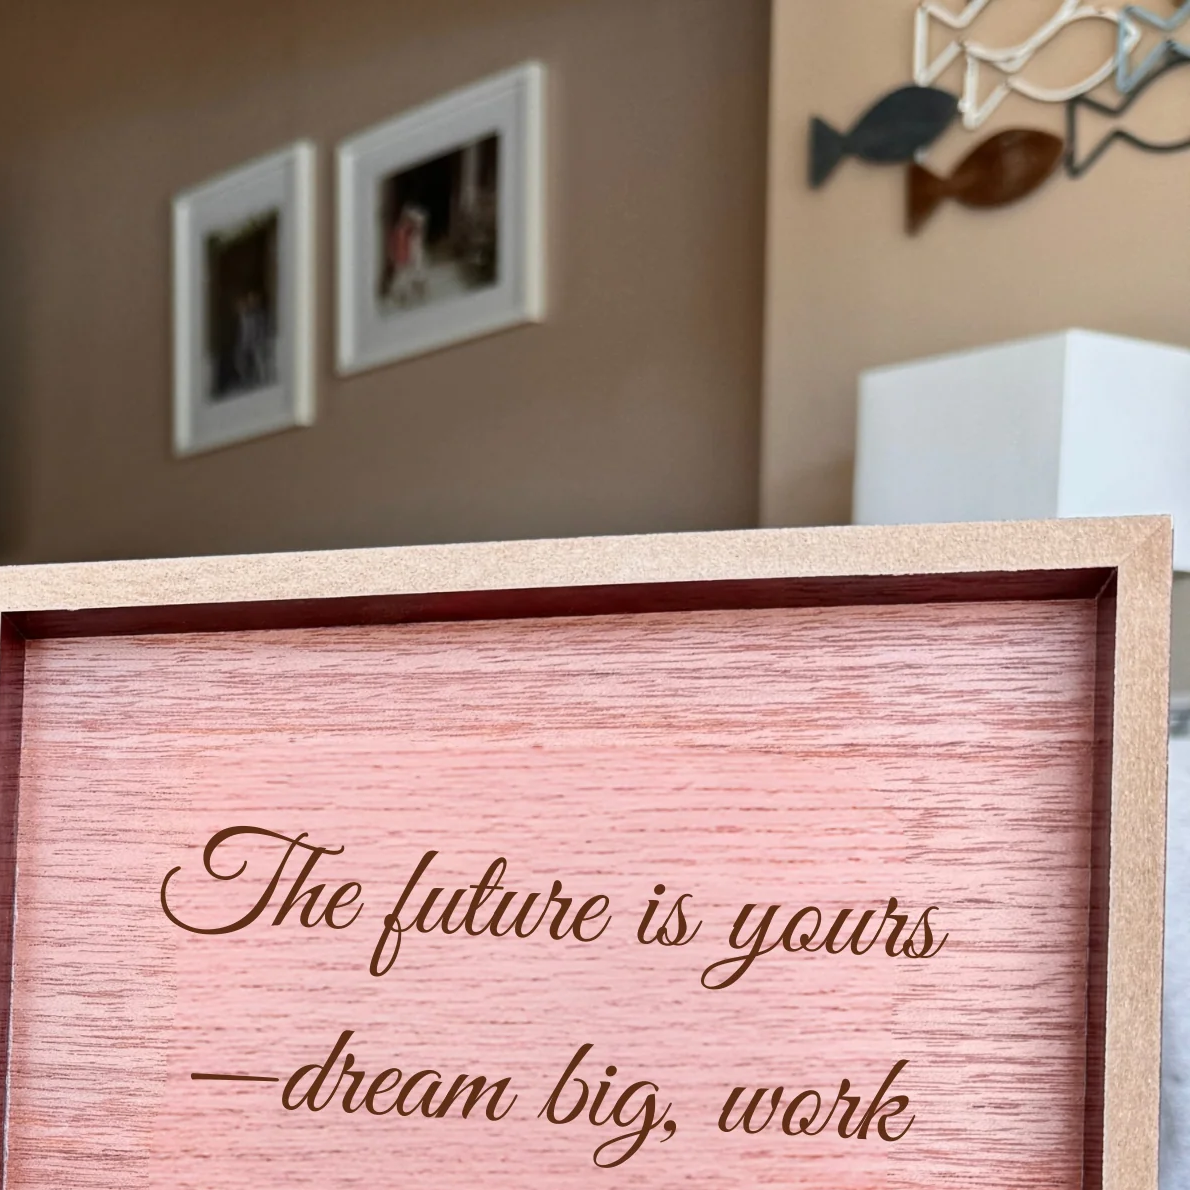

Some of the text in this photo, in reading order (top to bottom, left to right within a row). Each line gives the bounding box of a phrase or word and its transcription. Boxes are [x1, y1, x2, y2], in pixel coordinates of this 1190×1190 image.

[160, 825, 949, 990] The future is yours
[538, 1043, 677, 1169] big,
[717, 1059, 916, 1142] work
